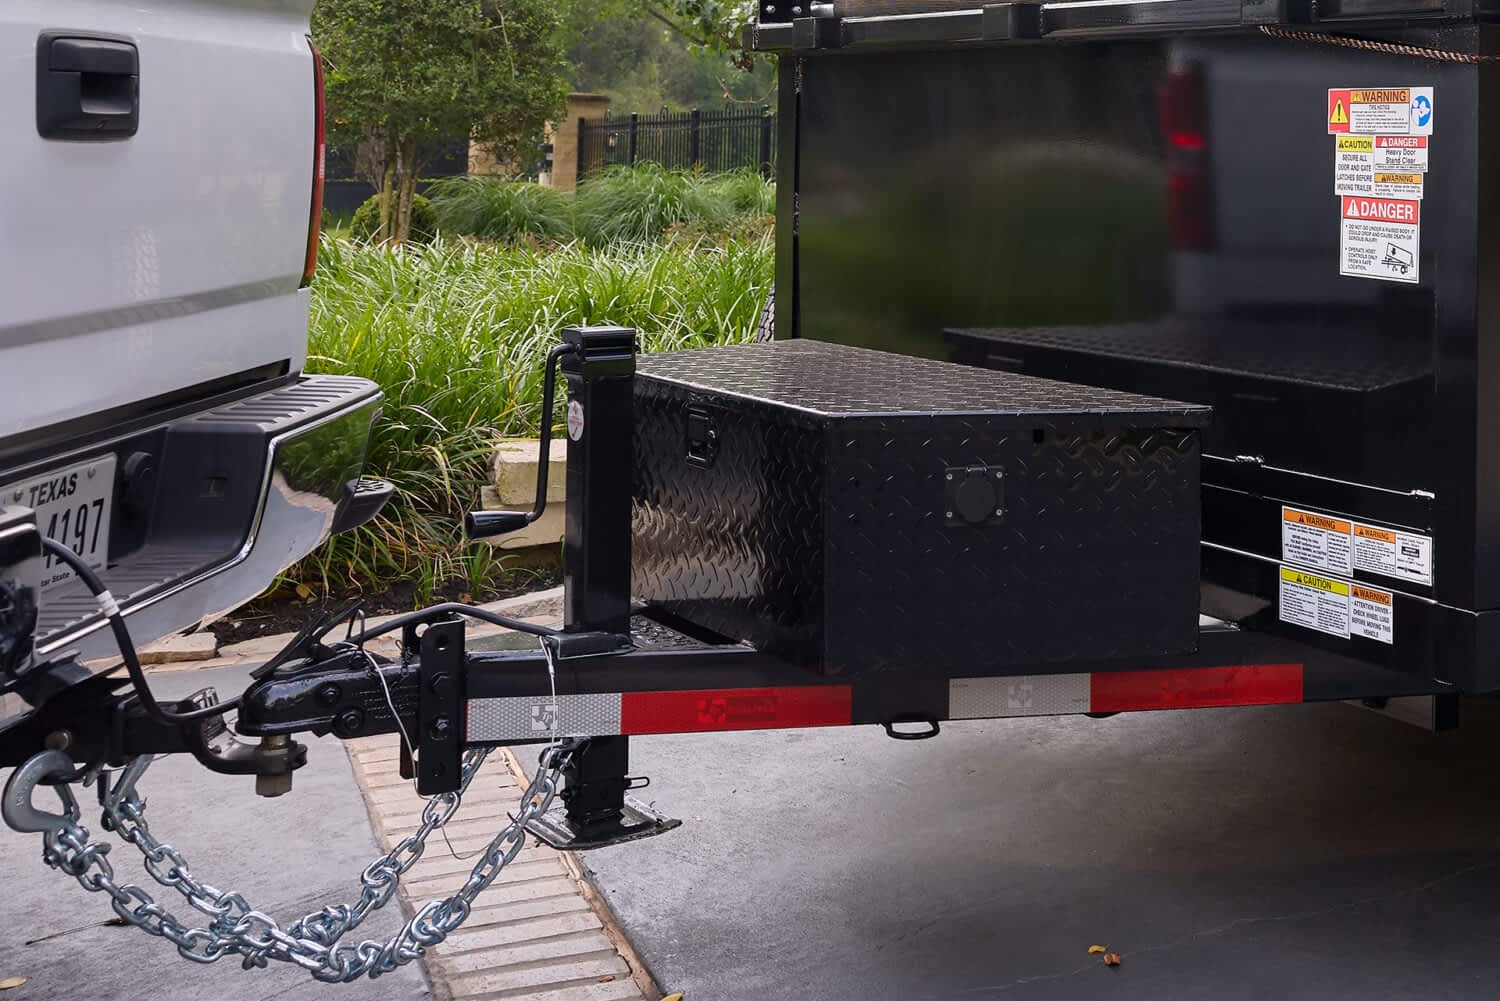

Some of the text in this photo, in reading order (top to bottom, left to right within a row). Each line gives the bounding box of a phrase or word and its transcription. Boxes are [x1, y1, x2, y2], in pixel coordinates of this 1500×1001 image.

[1361, 91, 1407, 102] WARNING
[1344, 140, 1373, 149] CAUTION
[1388, 138, 1418, 147] DANGER
[1385, 174, 1414, 182] WARNING
[1361, 201, 1413, 220] DANGER
[30, 473, 78, 508] TEXAS
[1305, 513, 1336, 530] WARNING
[1364, 529, 1389, 540] WARNING
[52, 572, 70, 583] State
[1303, 575, 1332, 590] CAUTION
[1360, 590, 1389, 604] WARNING
